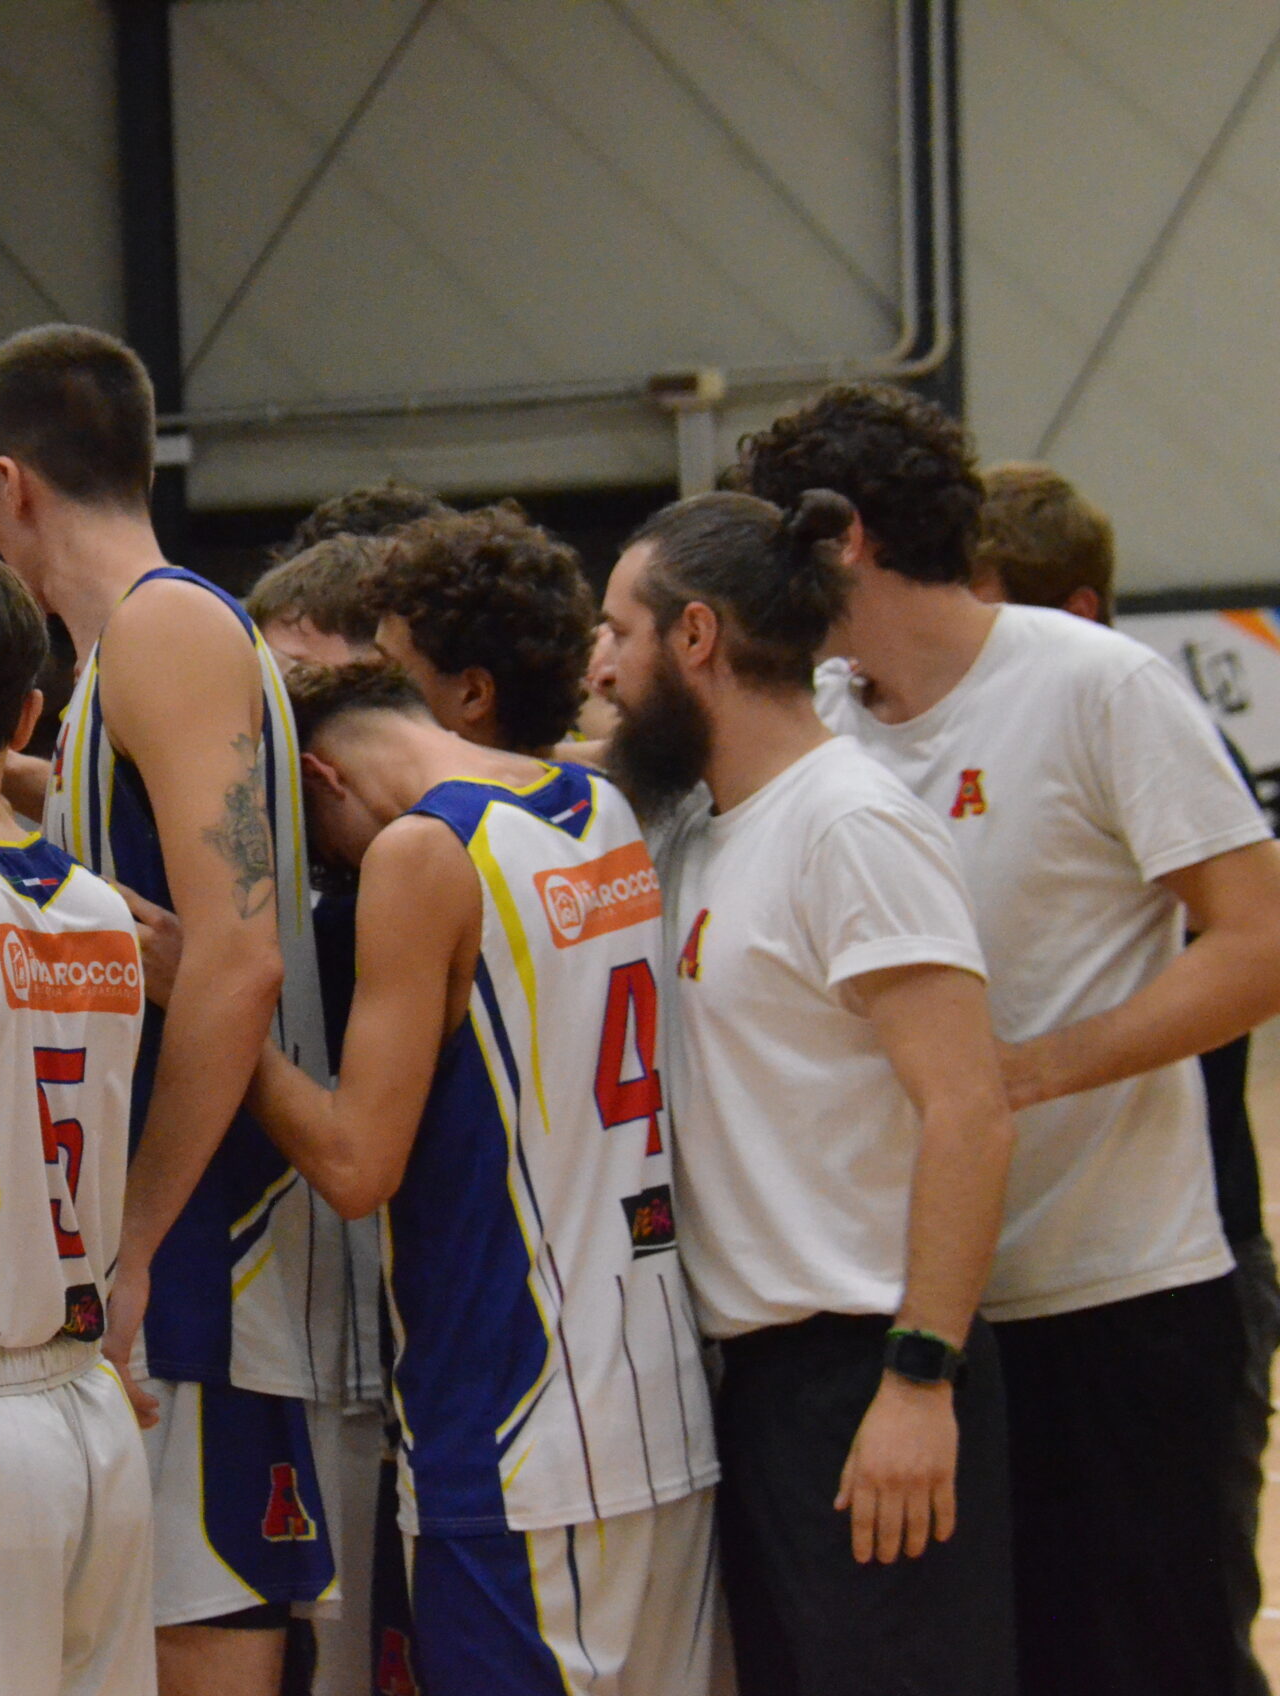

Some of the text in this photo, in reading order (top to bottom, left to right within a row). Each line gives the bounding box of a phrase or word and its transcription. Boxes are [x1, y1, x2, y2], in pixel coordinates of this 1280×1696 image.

[949, 768, 990, 820] A
[29, 957, 139, 988] MAROCCO
[594, 957, 663, 1157] 4
[33, 1046, 87, 1259] 5
[261, 1462, 318, 1542] A
